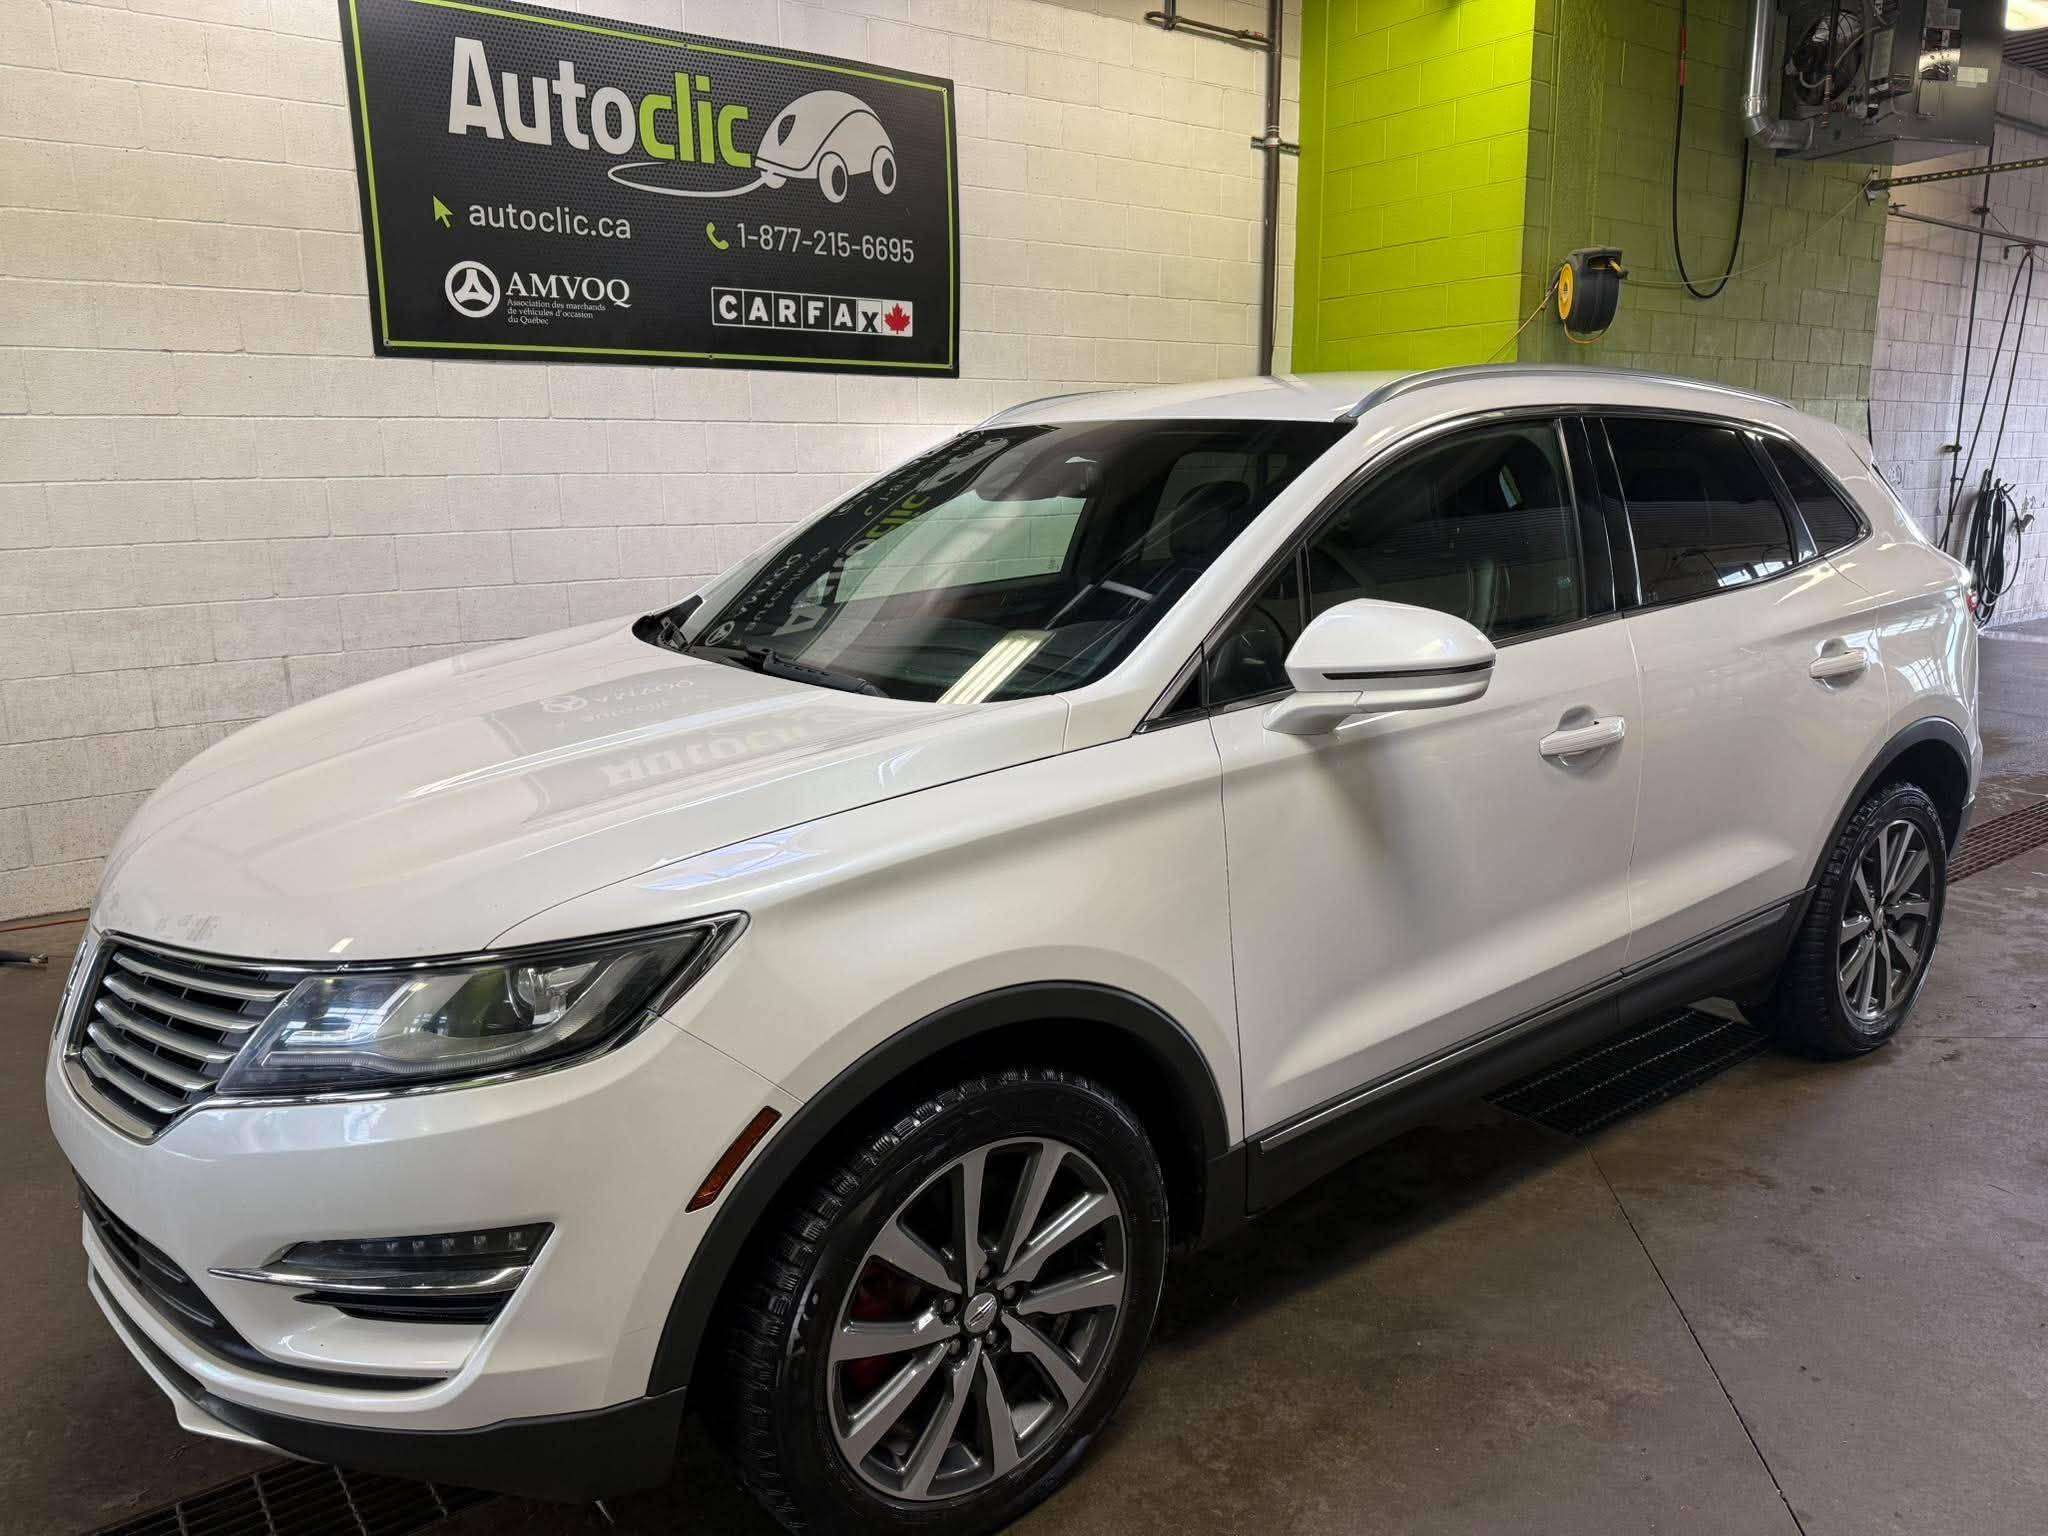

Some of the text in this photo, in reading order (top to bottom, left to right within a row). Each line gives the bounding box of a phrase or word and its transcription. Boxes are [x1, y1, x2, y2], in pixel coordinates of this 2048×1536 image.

[448, 36, 752, 169] Autoclic
[468, 203, 632, 239] autoclic.ca
[737, 222, 915, 264] 1-877-215-6695
[505, 271, 632, 308] AMVOQ
[507, 298, 606, 311] Association des marchands
[507, 306, 518, 315] de
[507, 315, 519, 323] du
[718, 294, 880, 333] CARFAX
